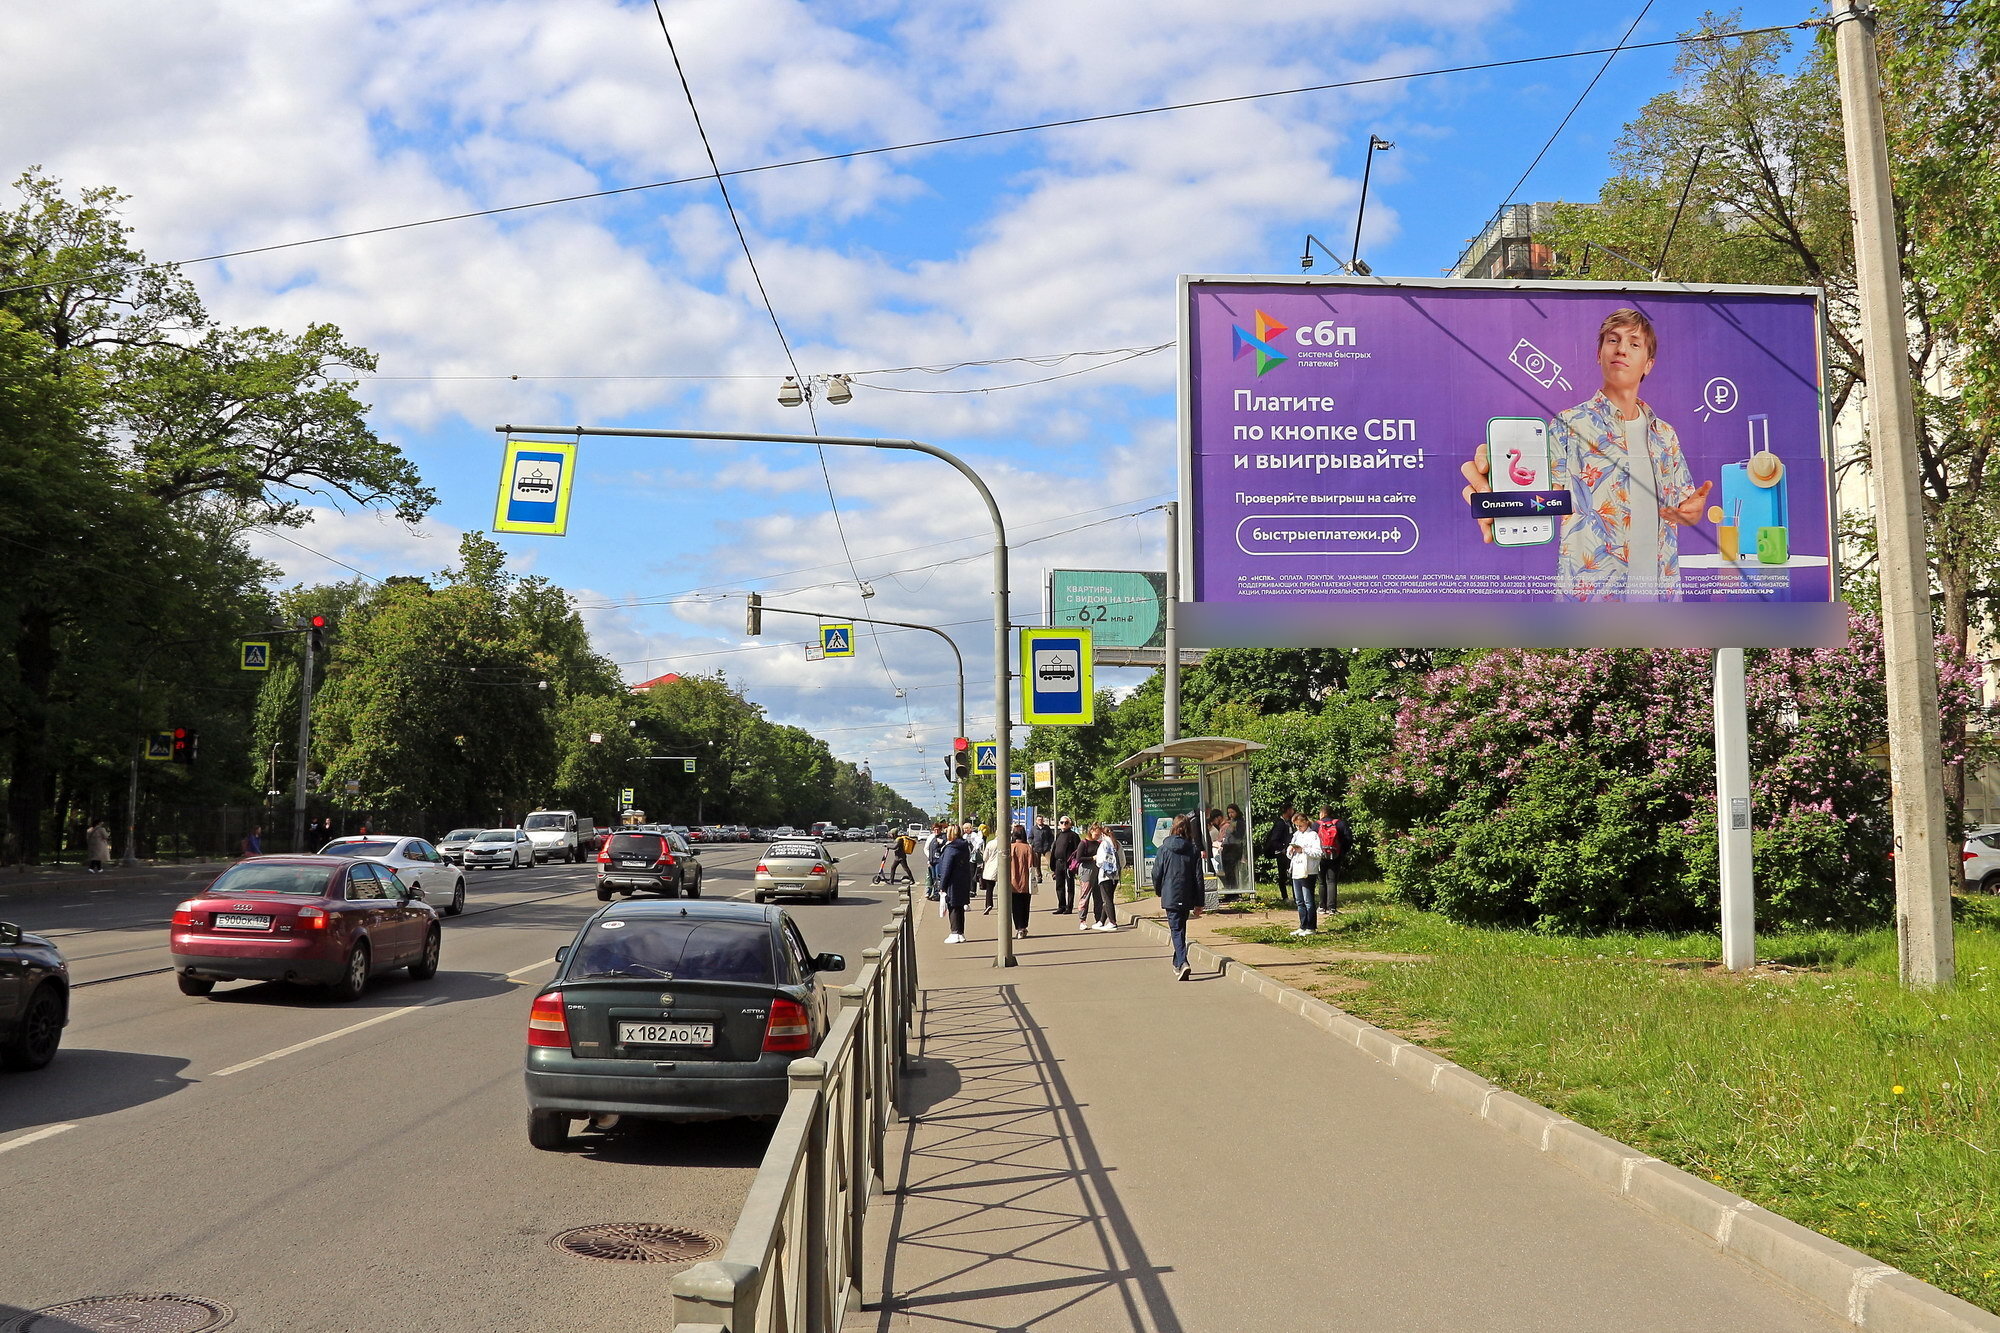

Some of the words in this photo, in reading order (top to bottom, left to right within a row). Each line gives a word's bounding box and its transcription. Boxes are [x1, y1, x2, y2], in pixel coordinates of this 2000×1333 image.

[1295, 320, 1357, 346] сбп
[1297, 350, 1333, 359] система
[1334, 350, 1372, 360] быстрых
[1297, 359, 1339, 368] платежей
[1233, 389, 1335, 412] Платите
[1233, 425, 1264, 441] по
[1270, 425, 1358, 441] кнопке
[1363, 419, 1416, 441] СБП
[1233, 454, 1249, 470] и
[1255, 448, 1425, 474] выигрывайте!
[1235, 492, 1309, 506] Проверяйте
[1310, 494, 1366, 505] выигрыш
[1366, 494, 1381, 503] на
[1382, 492, 1417, 503] сайте
[1481, 500, 1524, 509] Оплатить
[1546, 499, 1563, 508] сбп
[1252, 527, 1402, 544] быстрыеплатежи.рф
[1066, 585, 1113, 594] КВАРТИРЫ
[1066, 595, 1073, 603] С
[1075, 595, 1108, 604] ВИДОМ
[1110, 595, 1121, 604] НА
[1078, 605, 1108, 625] 6,2
[693, 1026, 709, 1039] 47
